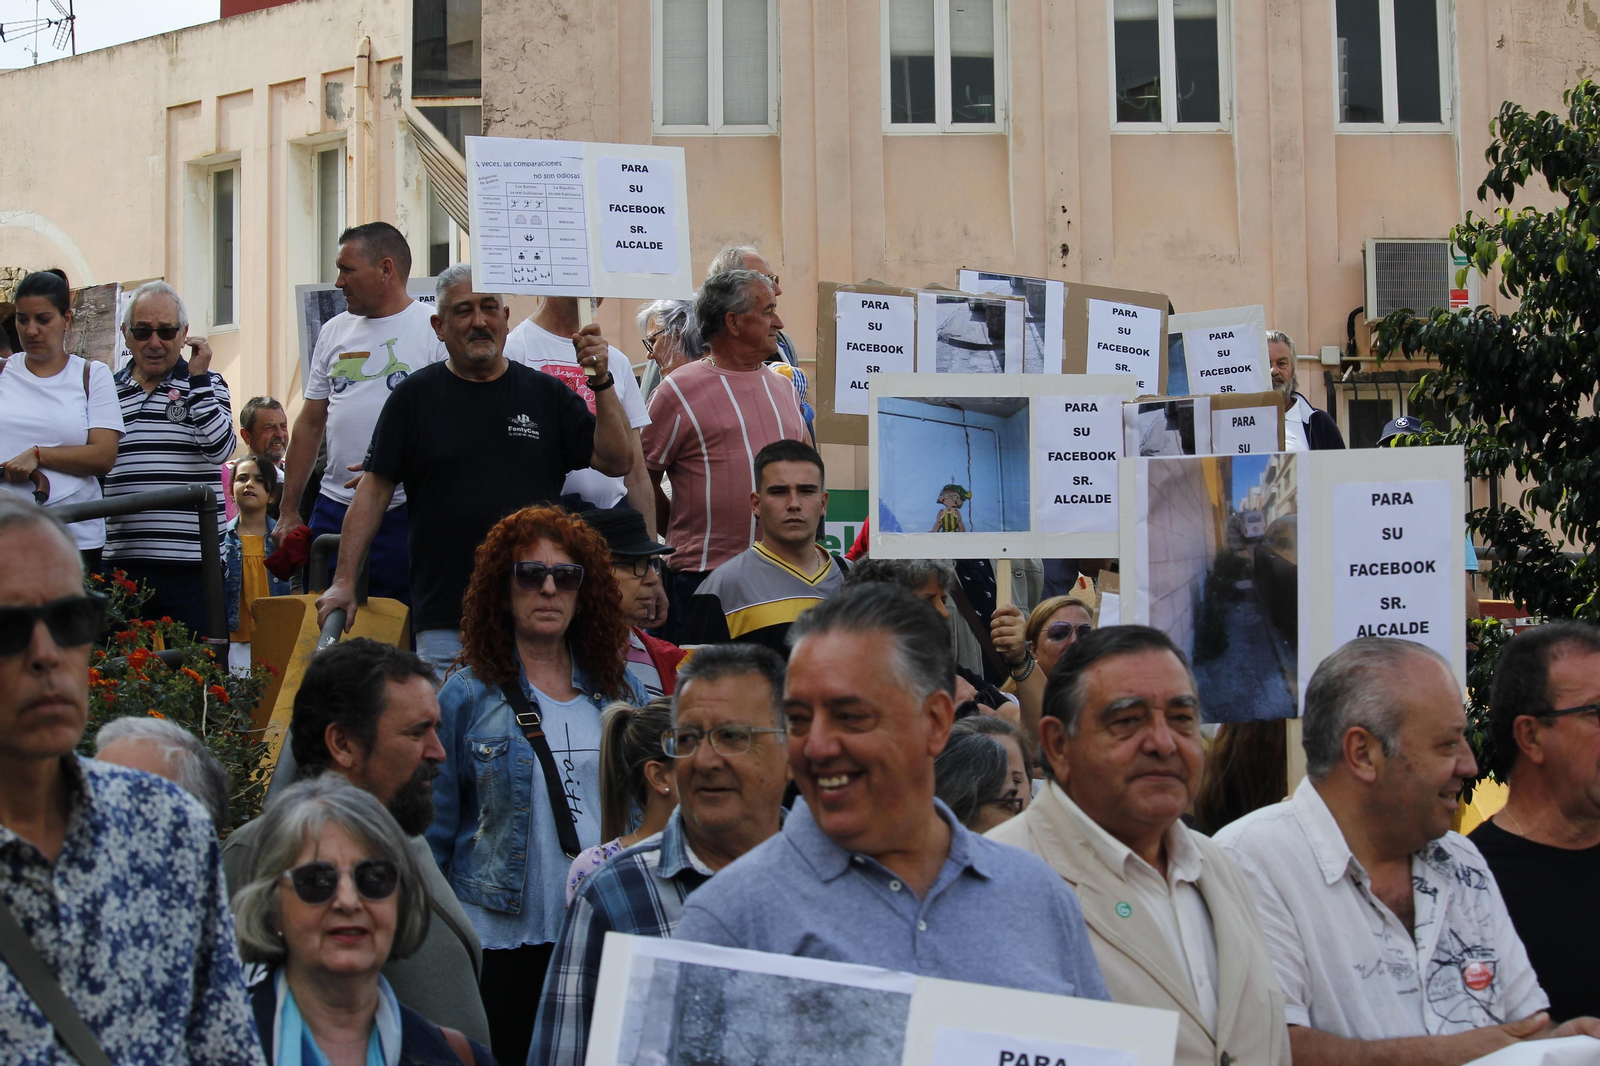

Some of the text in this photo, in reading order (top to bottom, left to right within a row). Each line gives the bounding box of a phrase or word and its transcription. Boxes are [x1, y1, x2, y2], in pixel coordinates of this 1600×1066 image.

[622, 164, 648, 173] PARA
[610, 204, 665, 214] FACEBOOK
[616, 241, 663, 249] ALCALDE
[862, 300, 889, 310] PARA
[1113, 307, 1138, 318] PARA
[868, 322, 882, 330] SU
[1118, 327, 1130, 335] SU
[1209, 332, 1234, 340] PARA
[847, 342, 903, 354] FACEBOOK
[1098, 342, 1149, 356] FACEBOOK
[1116, 363, 1130, 372] SR.
[1200, 365, 1251, 377] FACEBOOK
[1065, 403, 1098, 412] PARA
[1233, 416, 1255, 427] PARA
[1074, 428, 1090, 436] SU
[1239, 444, 1250, 453] SU
[1049, 452, 1116, 461] FACEBOOK
[1073, 476, 1092, 485] SR.
[1054, 495, 1111, 504] ALCALDE
[1372, 492, 1413, 506] PARA
[1383, 527, 1402, 540] SU
[1350, 561, 1435, 576] FACEBOOK
[1381, 597, 1405, 610] SR.
[1357, 621, 1429, 637] ALCALDE
[999, 1051, 1066, 1066] PARA
